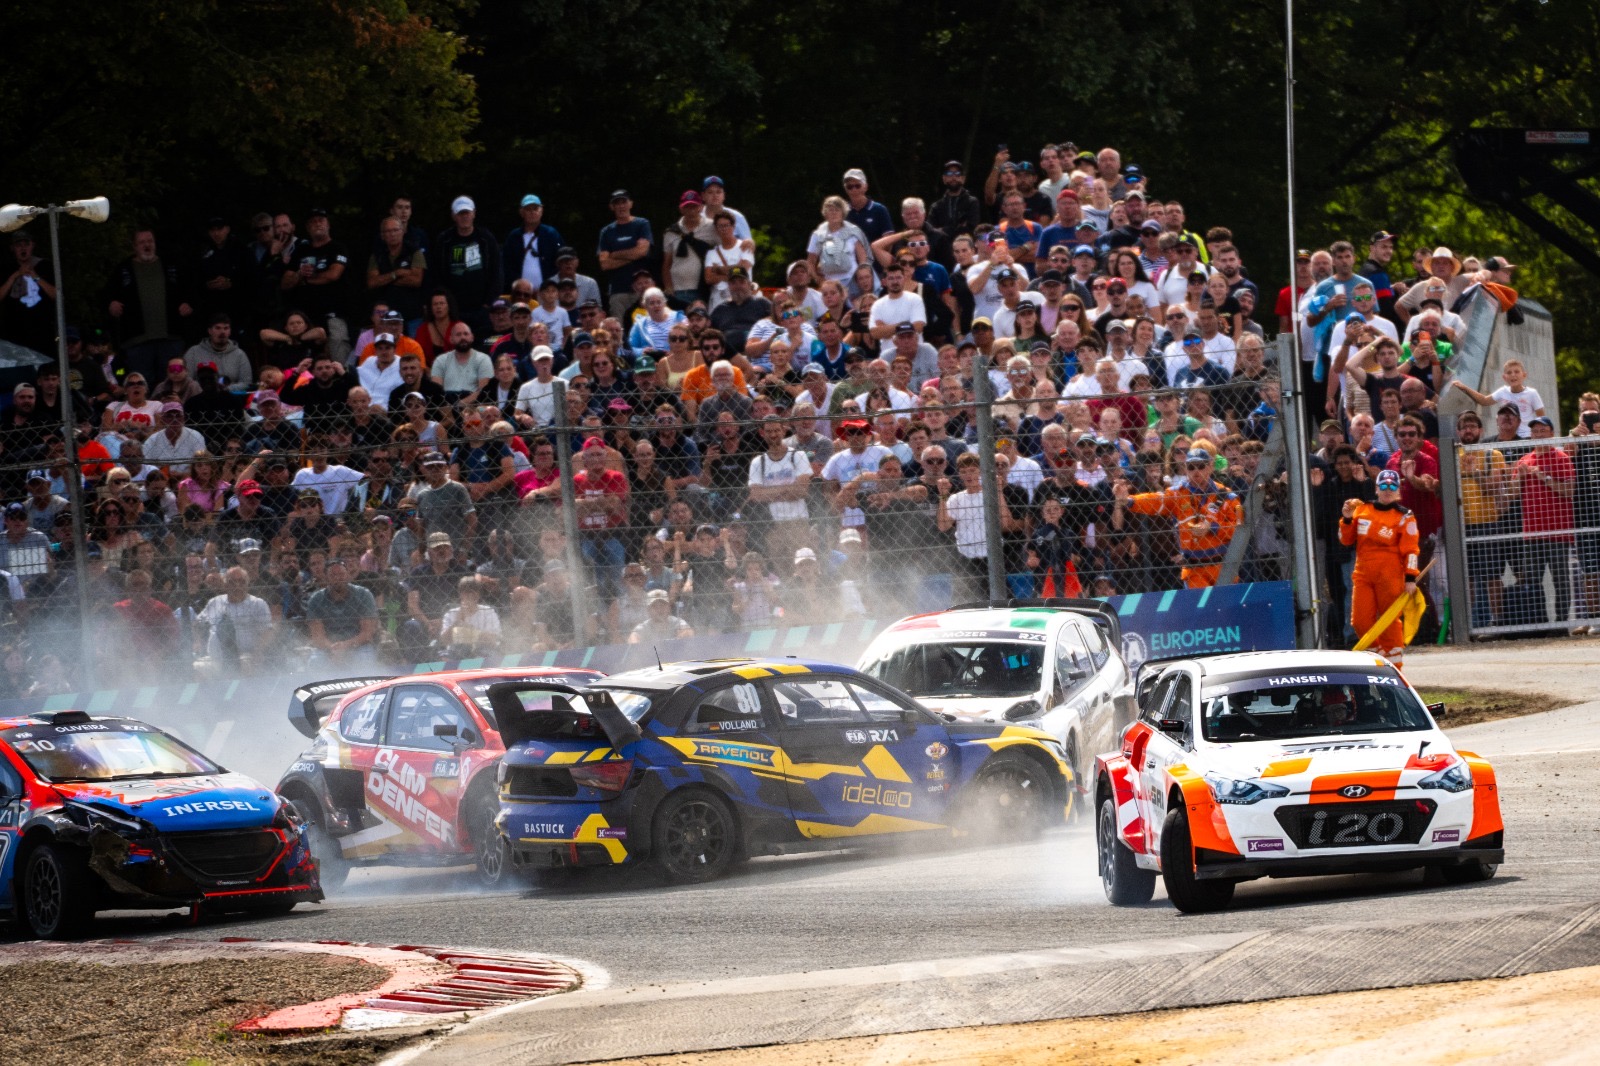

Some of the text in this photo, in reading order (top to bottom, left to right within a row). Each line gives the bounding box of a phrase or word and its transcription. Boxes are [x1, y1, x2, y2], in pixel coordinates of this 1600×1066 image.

[1018, 632, 1047, 641] RX1
[1151, 626, 1241, 651] EUROPEAN
[1269, 675, 1328, 686] HANSEN
[1367, 675, 1399, 685] RX1
[310, 680, 364, 695] DRIVING
[1202, 696, 1230, 716] 71
[55, 724, 109, 733] OLIVEIRA
[719, 720, 757, 730] VOLLAND
[869, 729, 899, 741] RX1
[29, 740, 55, 752] 10
[700, 745, 769, 762] RAVENOL
[375, 749, 426, 796] CLIM
[163, 800, 260, 817] INERSEL
[368, 772, 455, 848] DENFER
[524, 823, 564, 834] BASTUCK
